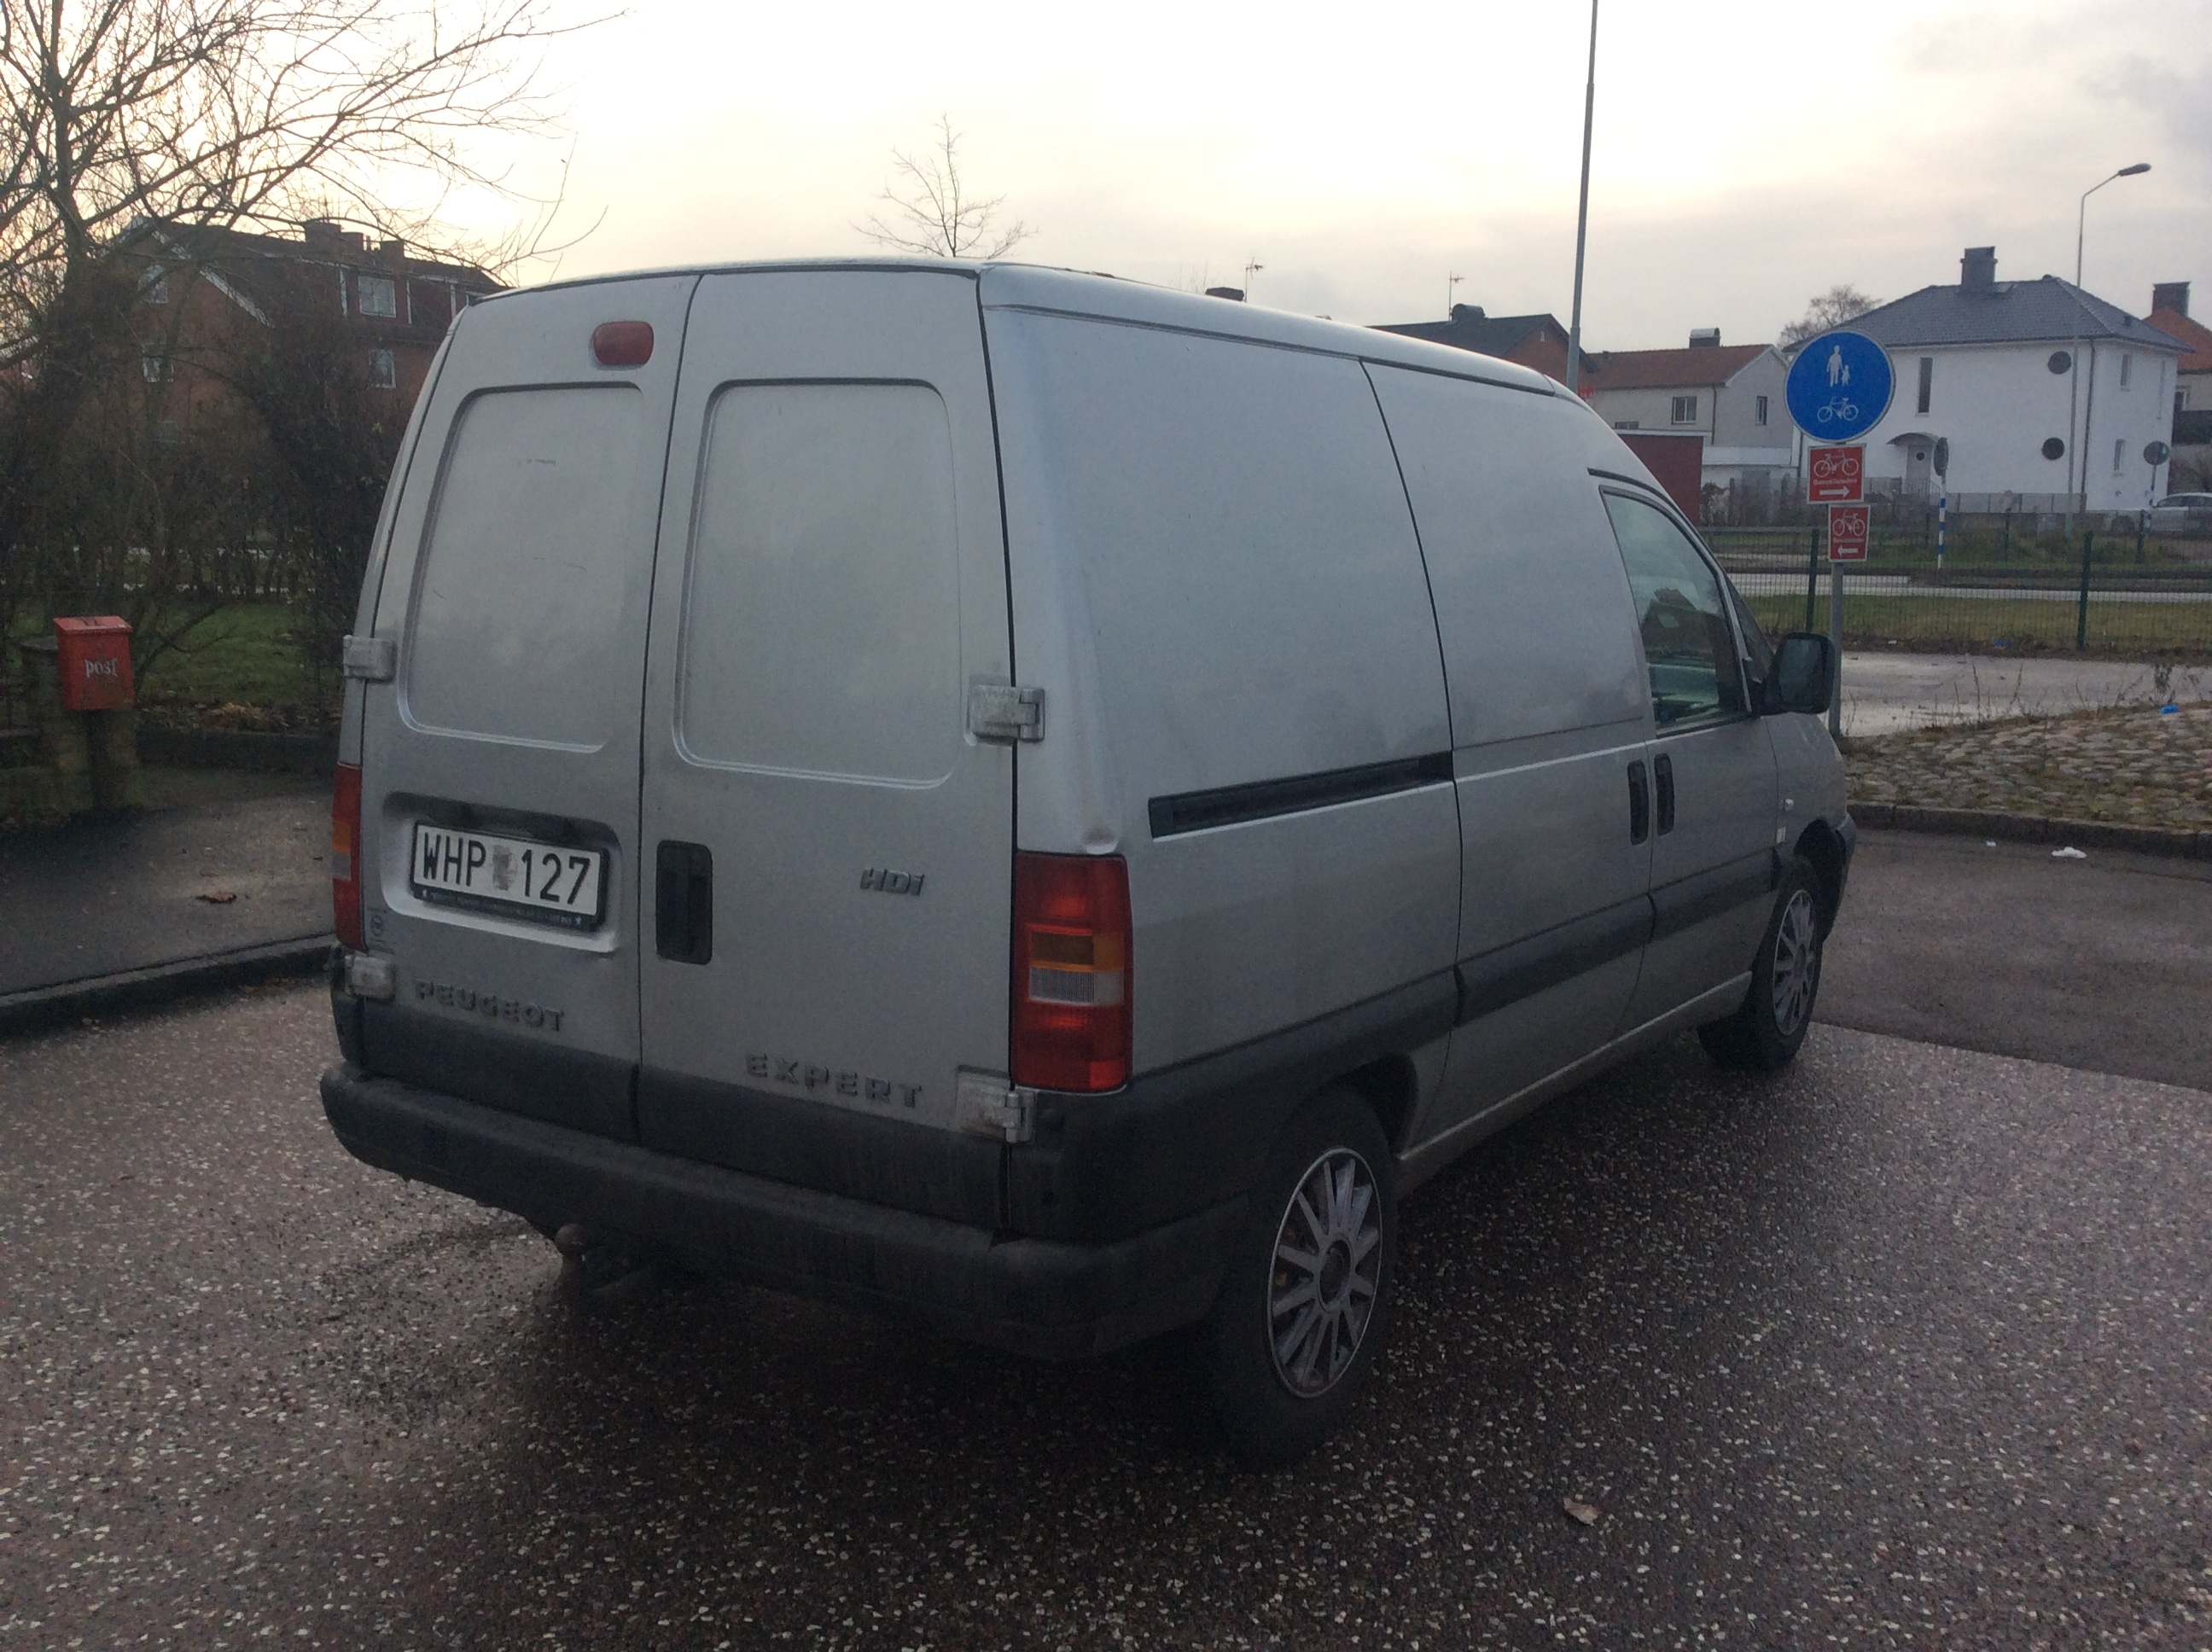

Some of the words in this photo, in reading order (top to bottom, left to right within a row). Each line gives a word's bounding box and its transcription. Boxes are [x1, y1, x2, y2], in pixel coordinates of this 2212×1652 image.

[423, 832, 486, 887] WHP
[521, 849, 591, 905] 127
[415, 980, 565, 1032] PEUGEOT
[746, 1054, 922, 1108] EXPERT
